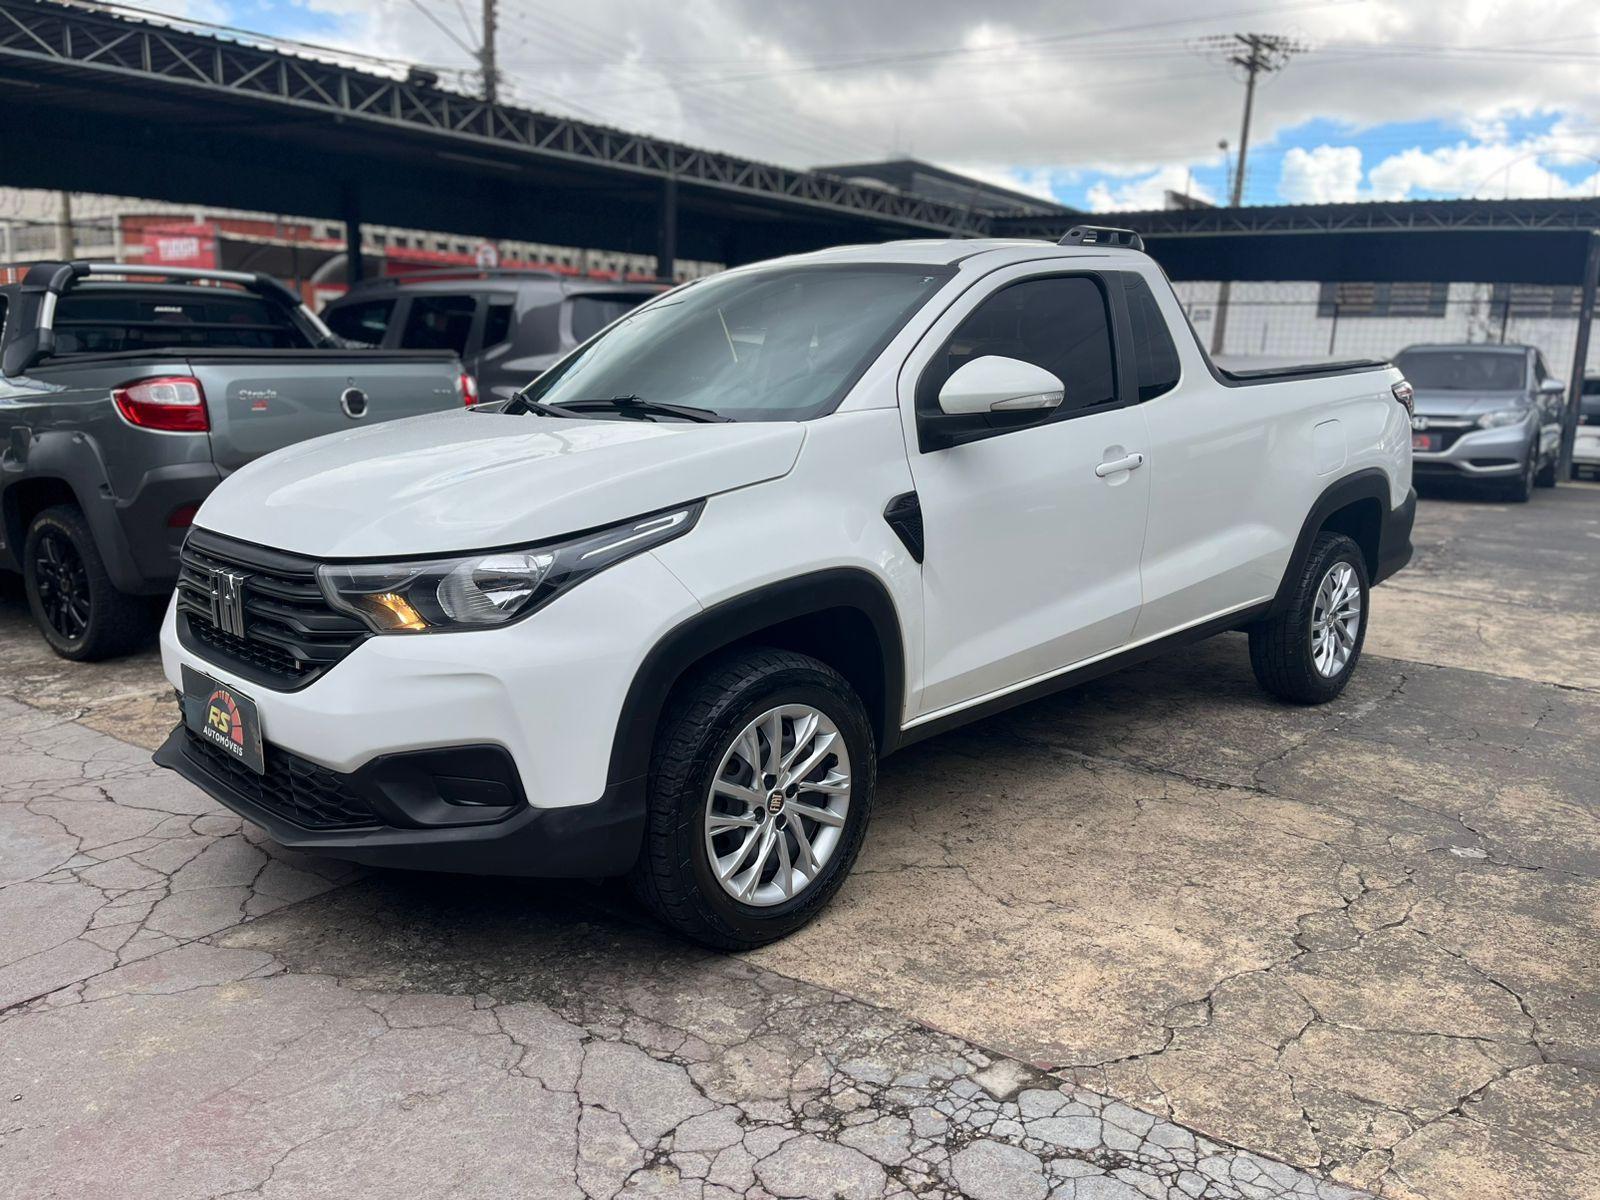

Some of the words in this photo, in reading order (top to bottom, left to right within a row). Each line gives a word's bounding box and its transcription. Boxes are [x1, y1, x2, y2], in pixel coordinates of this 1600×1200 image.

[209, 568, 245, 639] FIAT
[208, 705, 231, 733] RS
[203, 725, 244, 757] AUTOMÓVEIS
[769, 794, 783, 811] FIAT
